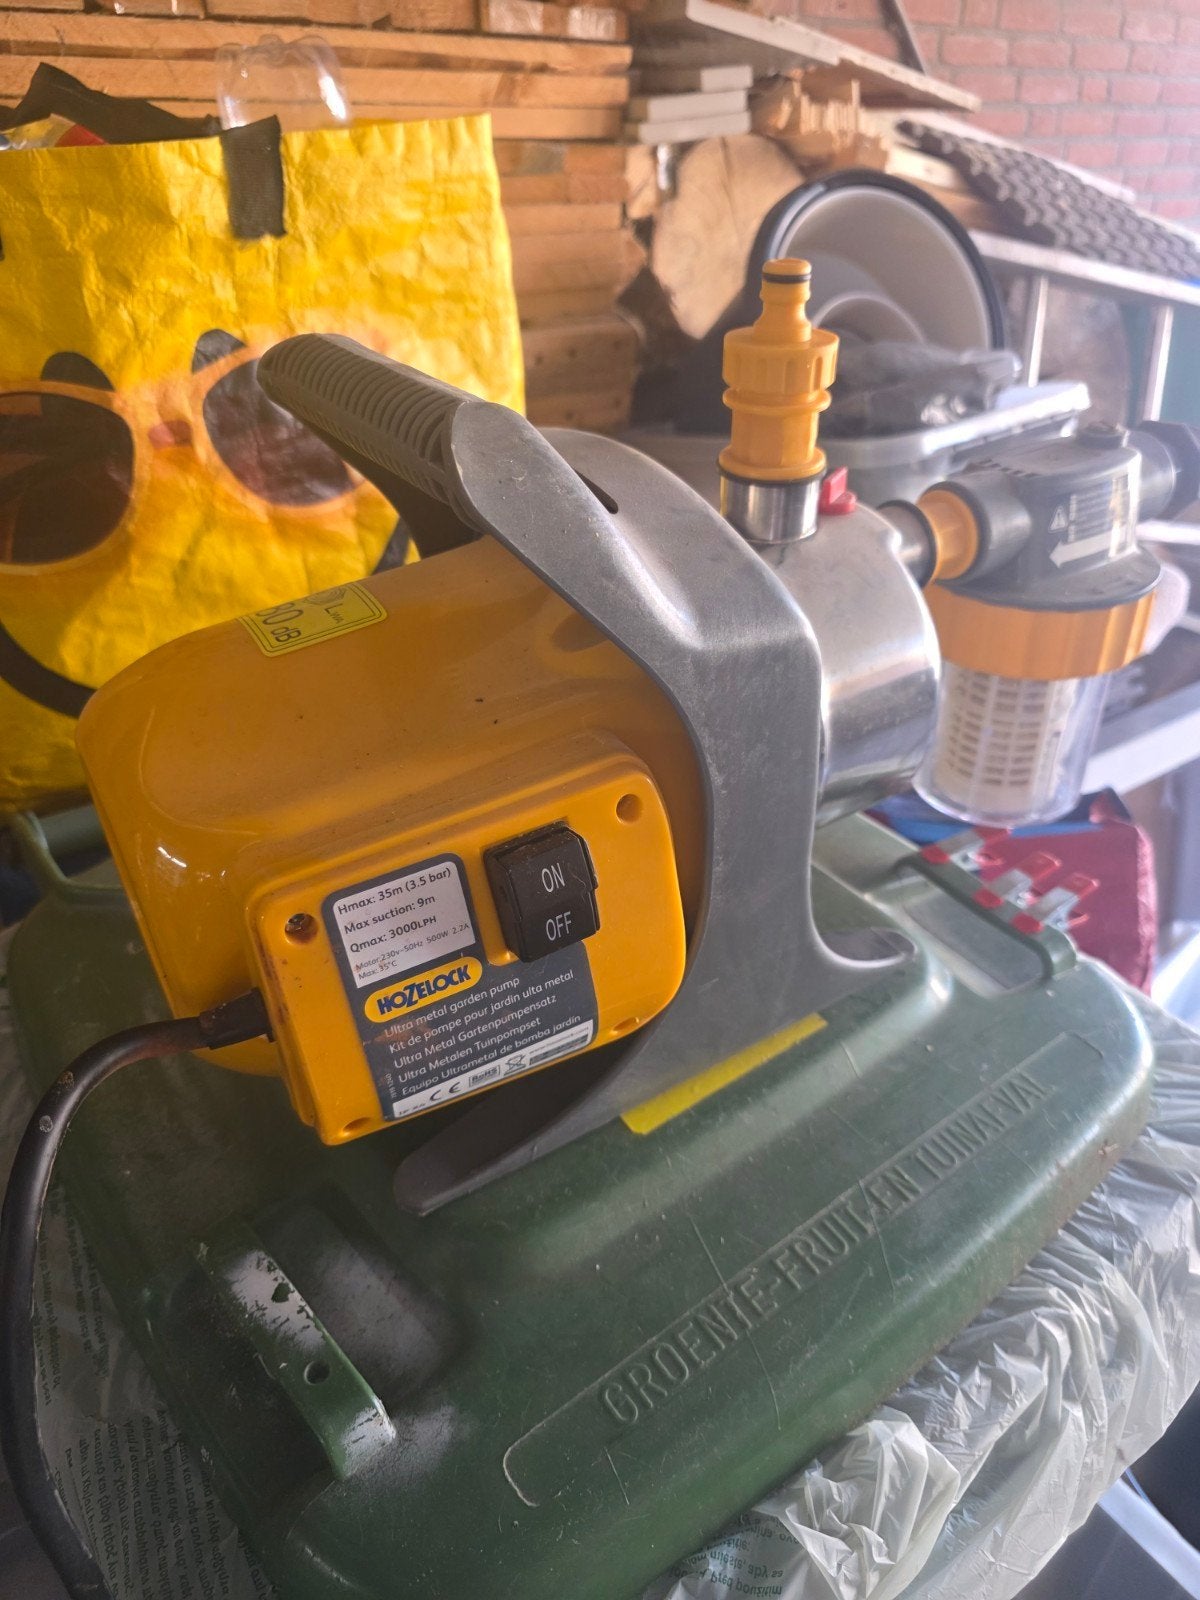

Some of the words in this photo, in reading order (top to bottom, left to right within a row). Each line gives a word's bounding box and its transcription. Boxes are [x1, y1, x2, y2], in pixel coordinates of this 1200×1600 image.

[271, 627, 302, 643] dB
[338, 896, 375, 915] Hmax:
[378, 886, 403, 902] 35m
[406, 876, 426, 891] (3.5
[429, 868, 451, 882] bar)
[541, 862, 566, 893] ON
[344, 921, 372, 934] Max
[373, 902, 415, 924] suction:
[417, 896, 436, 908] 9m
[350, 934, 386, 953] Qmax:
[390, 916, 436, 939] 3000LPH
[426, 931, 448, 943] 500W
[452, 923, 470, 935] 2.2A
[545, 911, 572, 941] OFF
[358, 968, 378, 980] Max:
[377, 964, 471, 1015] HOZELOCK
[385, 1021, 413, 1038] Ultra
[416, 1007, 448, 1026] metal
[450, 991, 488, 1014] garden
[490, 977, 520, 998] pump
[389, 1041, 405, 1054] Kit
[408, 1035, 421, 1046] de
[424, 1019, 462, 1041] pompe
[464, 1009, 493, 1026] pour
[491, 993, 520, 1015] jardin
[523, 985, 543, 998] ulta
[545, 970, 574, 990] metal
[394, 1054, 422, 1069] Ultra
[425, 1038, 456, 1057] Metal
[458, 996, 557, 1041] Gartenpumpensatz
[399, 1068, 426, 1083] Ultra
[429, 1048, 472, 1071] Metalen
[475, 1017, 541, 1052] Tuinpompset
[402, 1074, 438, 1096] Equipo
[441, 1050, 498, 1079] Ultrametal
[500, 1044, 512, 1054] de
[515, 1030, 550, 1047] bomba
